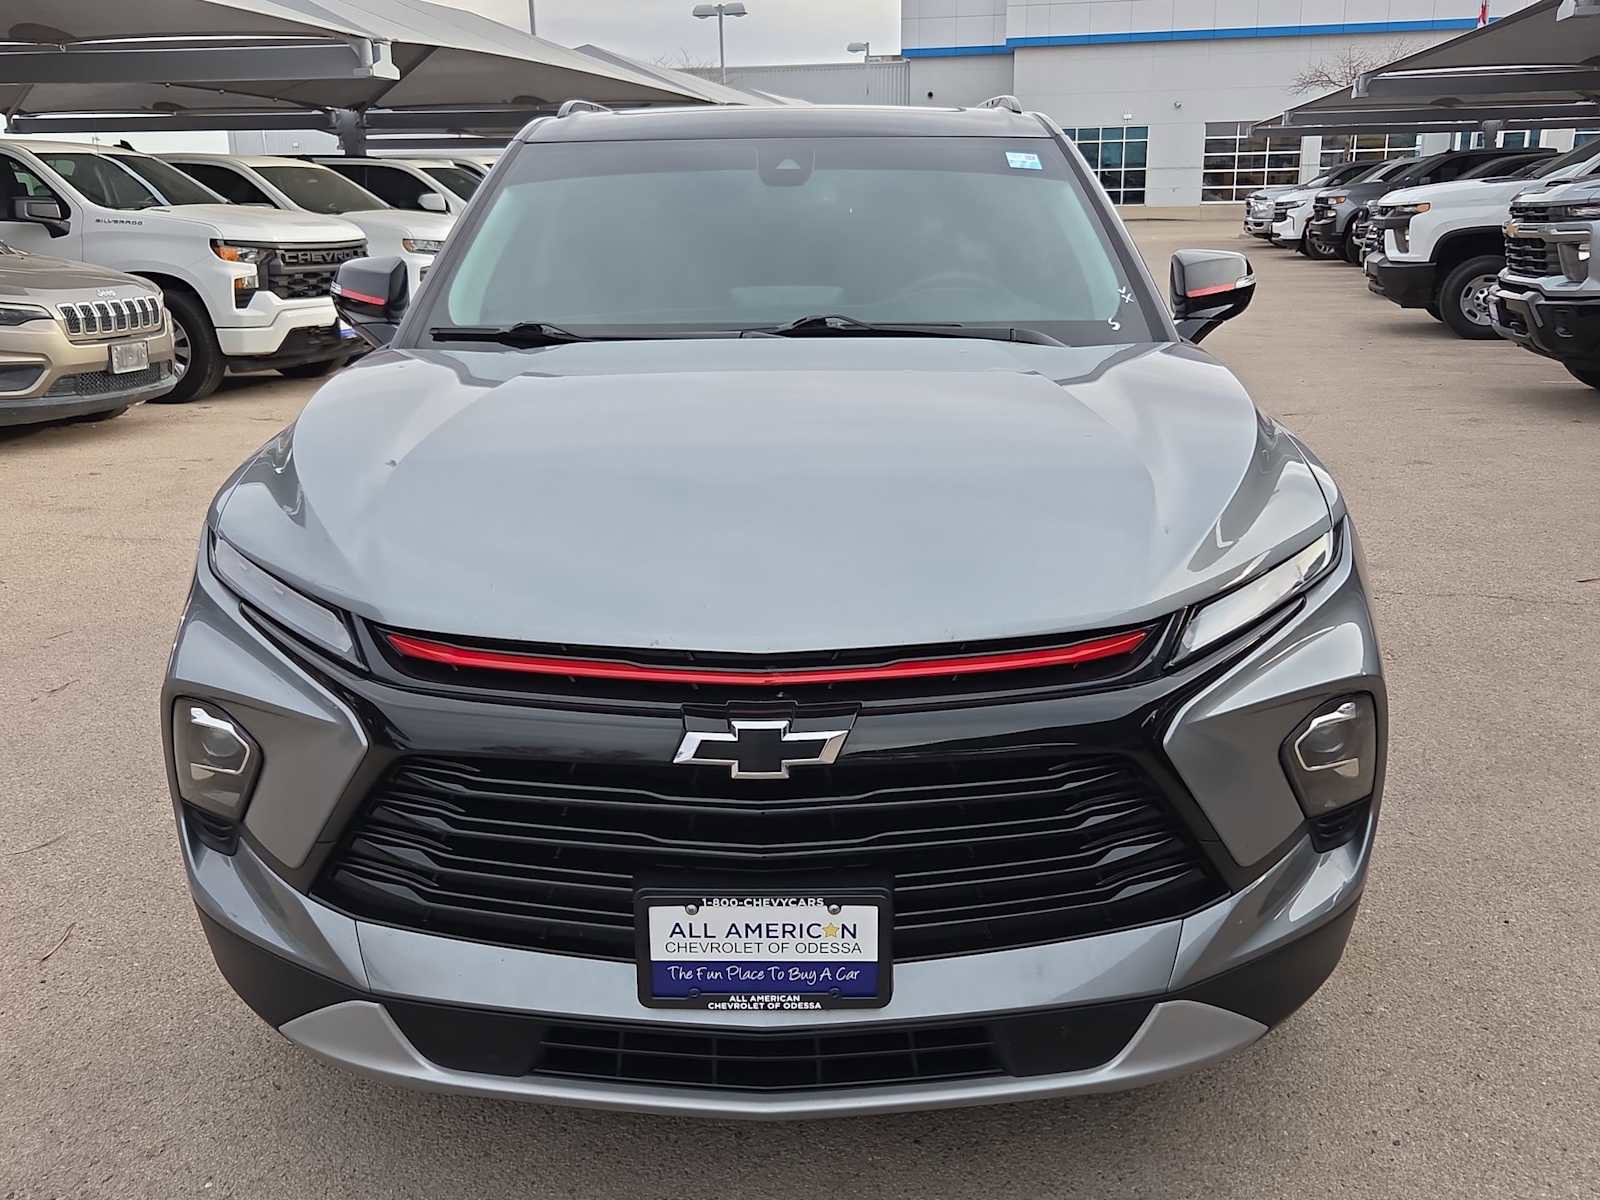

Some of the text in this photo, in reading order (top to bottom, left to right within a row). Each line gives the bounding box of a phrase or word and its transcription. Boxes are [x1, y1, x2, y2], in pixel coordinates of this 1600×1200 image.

[702, 898, 825, 907] 1-800-CHEVYCARS
[669, 922, 857, 939] ALL AMERICN
[665, 942, 862, 954] CHEVROLET OF ODESSA
[667, 966, 860, 985] The Fun Place To Buy A Car
